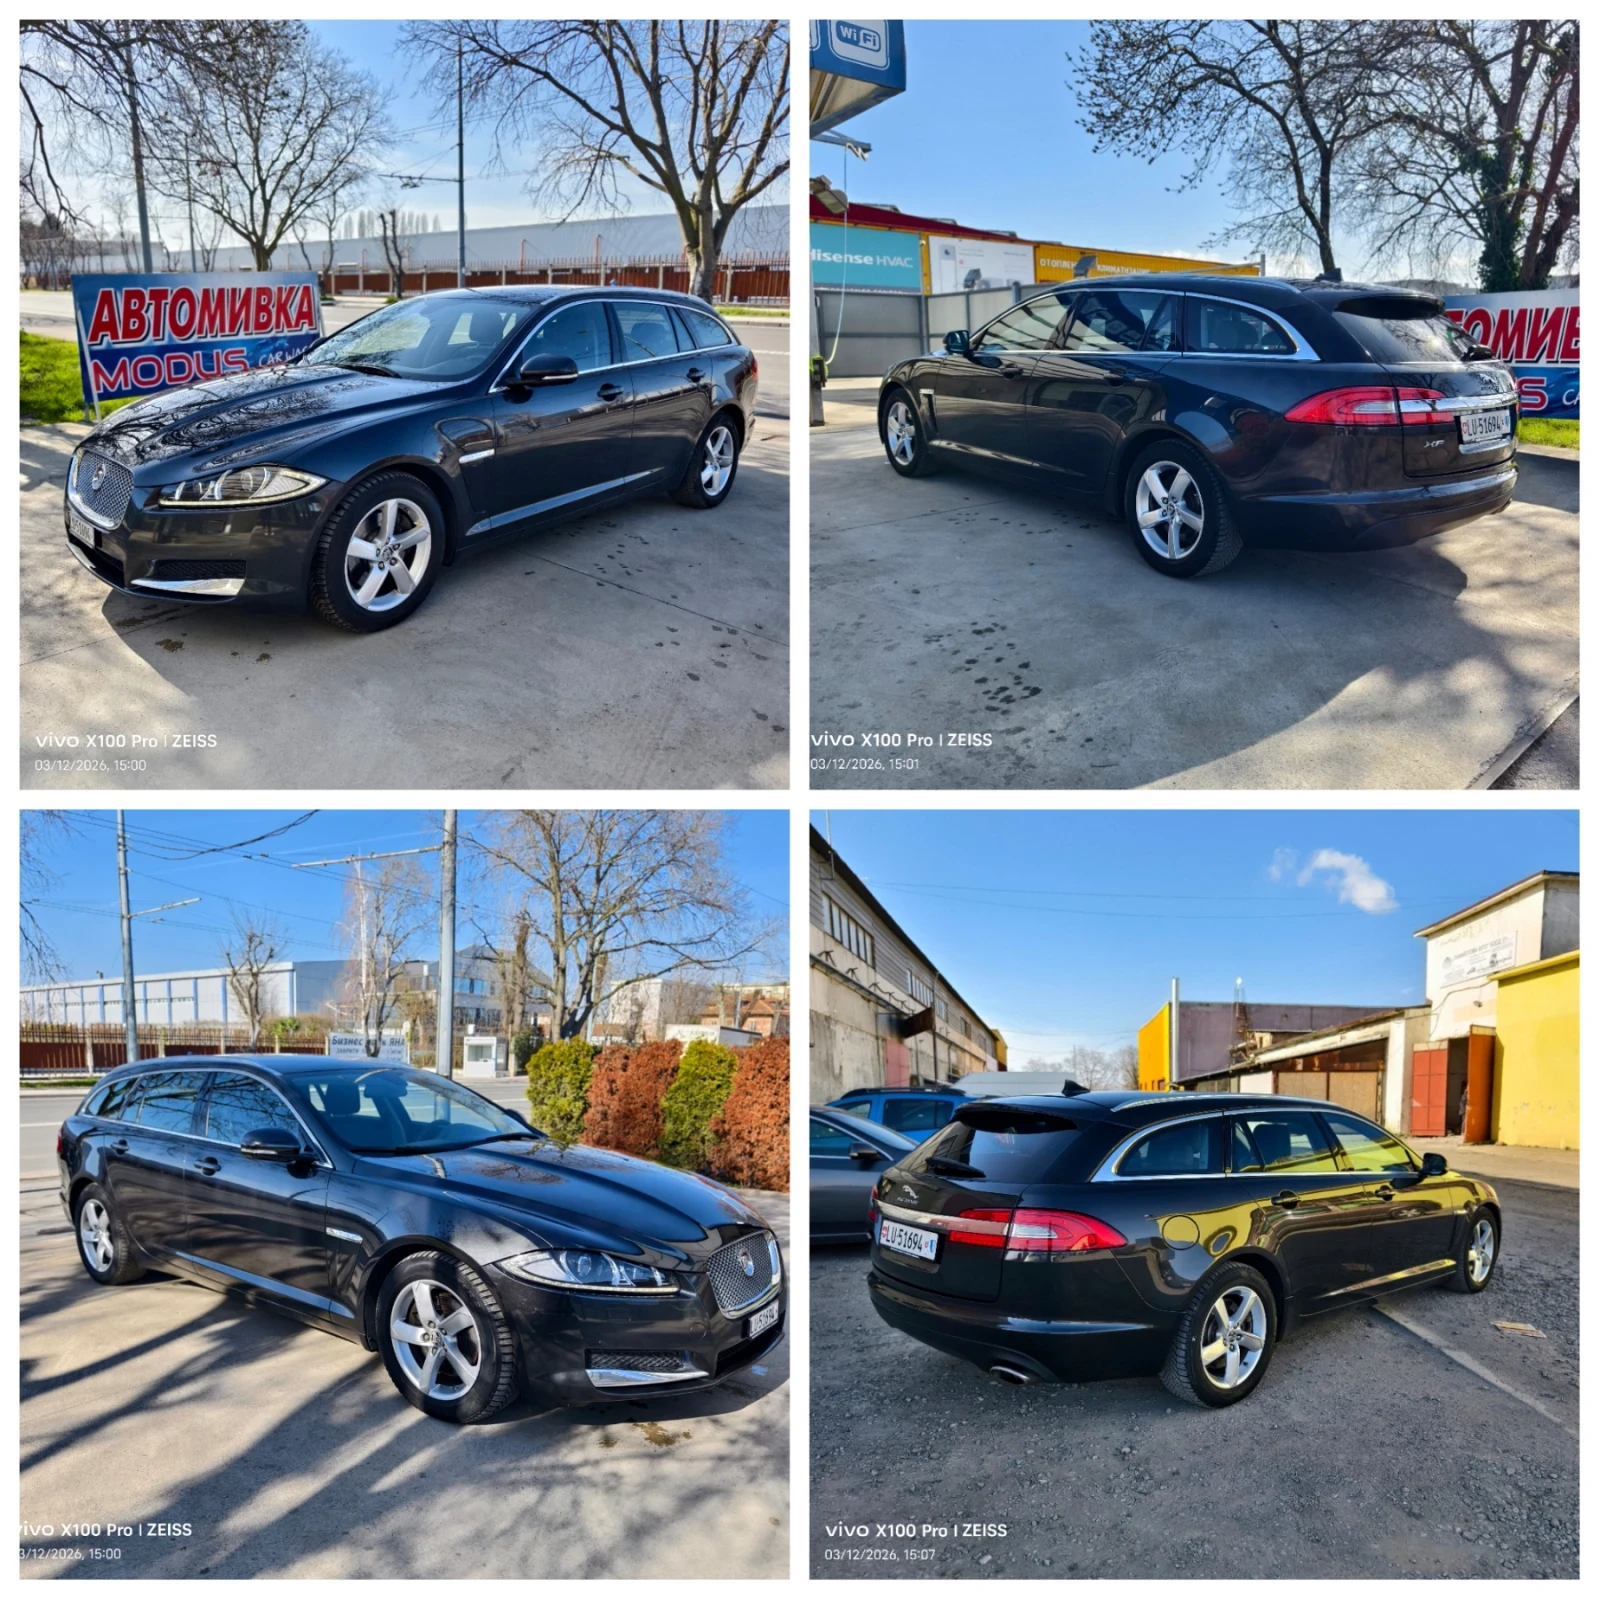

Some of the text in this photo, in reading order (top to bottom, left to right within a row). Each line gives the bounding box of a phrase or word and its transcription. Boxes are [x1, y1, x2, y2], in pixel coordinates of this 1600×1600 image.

[876, 255, 914, 268] HVAC
[1040, 259, 1077, 269] ОТОПЛЕН
[87, 284, 317, 345] АВТОМИВКА
[91, 347, 249, 393] MODUS
[332, 1035, 363, 1046] Бизнес
